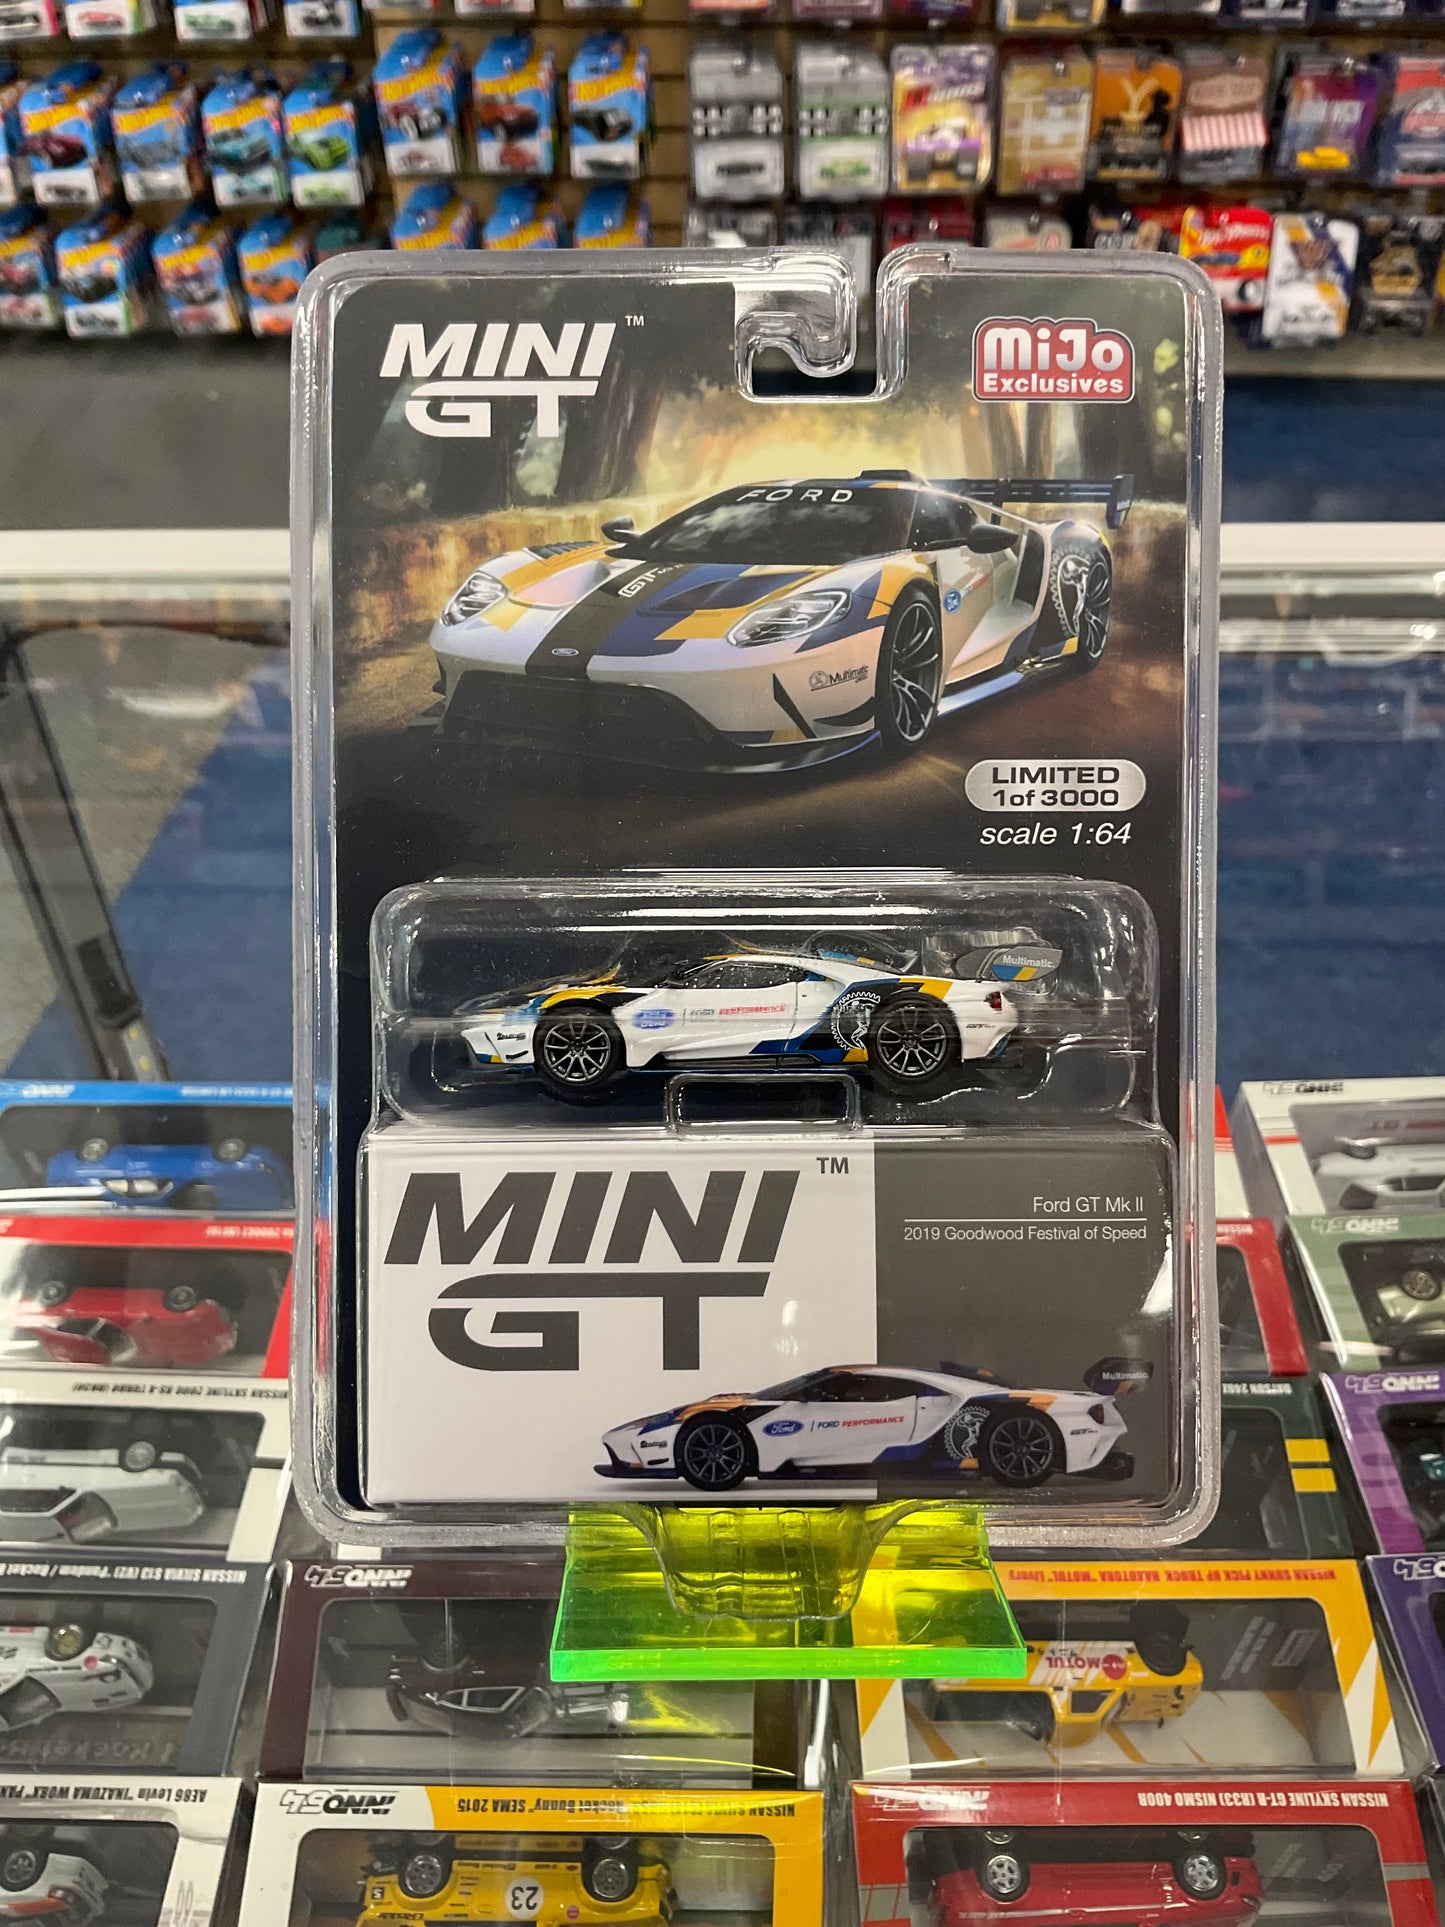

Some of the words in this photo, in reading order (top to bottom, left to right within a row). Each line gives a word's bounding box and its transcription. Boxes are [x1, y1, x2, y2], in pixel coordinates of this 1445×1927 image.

[379, 323, 616, 377] MINI
[983, 373, 1124, 393] Exclusives
[404, 380, 599, 438] GT
[735, 489, 853, 502] FORD
[992, 767, 1120, 784] LIMITED
[979, 822, 1058, 845] scale
[1071, 822, 1132, 845] 1:64
[1033, 1196, 1070, 1213] Ford
[1075, 1196, 1101, 1213] GT
[1106, 1197, 1132, 1213] Mk
[383, 1170, 801, 1265] MINI
[904, 1227, 941, 1241] 2019
[944, 1226, 1024, 1241] Goodwood
[1028, 1226, 1081, 1240] Festival
[1084, 1226, 1099, 1240] of
[1102, 1225, 1147, 1242] Speed
[428, 1271, 771, 1371] GT
[817, 1420, 840, 1429] FORD
[841, 1416, 905, 1428] PERFORMANCE
[304, 1565, 413, 1588] INNO64
[1046, 1657, 1100, 1669] MOTUL
[137, 1787, 172, 1802] Levin
[174, 1789, 208, 1803] AE86
[280, 1789, 399, 1815] INNO64
[1138, 1792, 1171, 1807] 400R
[1175, 1792, 1217, 1807] NISMO
[1218, 1793, 1256, 1807] (R33)
[1258, 1793, 1287, 1807] GT-R
[1290, 1792, 1340, 1807] SKYLINE
[1342, 1792, 1389, 1807] NISSAN
[457, 1798, 488, 1813] 2015
[491, 1798, 526, 1813] SEMA
[511, 1886, 539, 1911] 23
